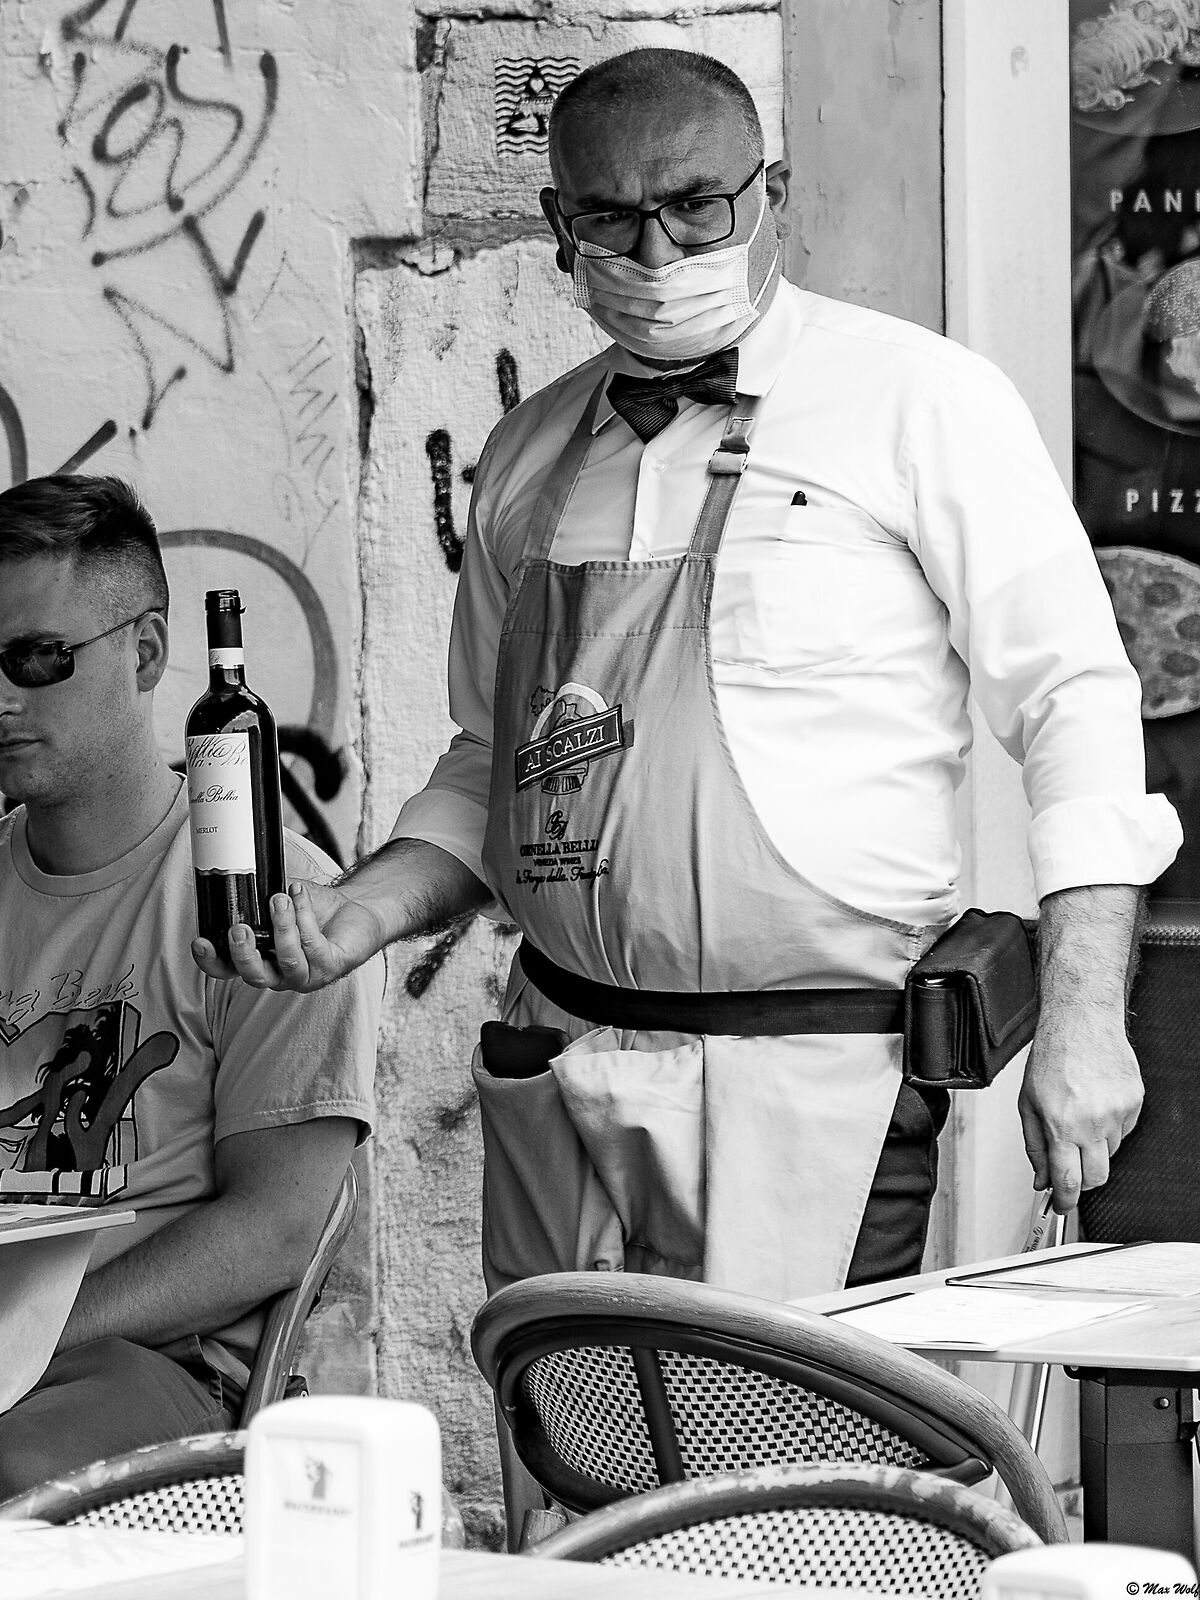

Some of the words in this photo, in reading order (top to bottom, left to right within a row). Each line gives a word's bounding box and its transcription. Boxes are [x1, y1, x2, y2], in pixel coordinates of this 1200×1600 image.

[525, 750, 541, 773] AI
[546, 725, 605, 762] SCALZI
[520, 842, 561, 857] ORNELLA
